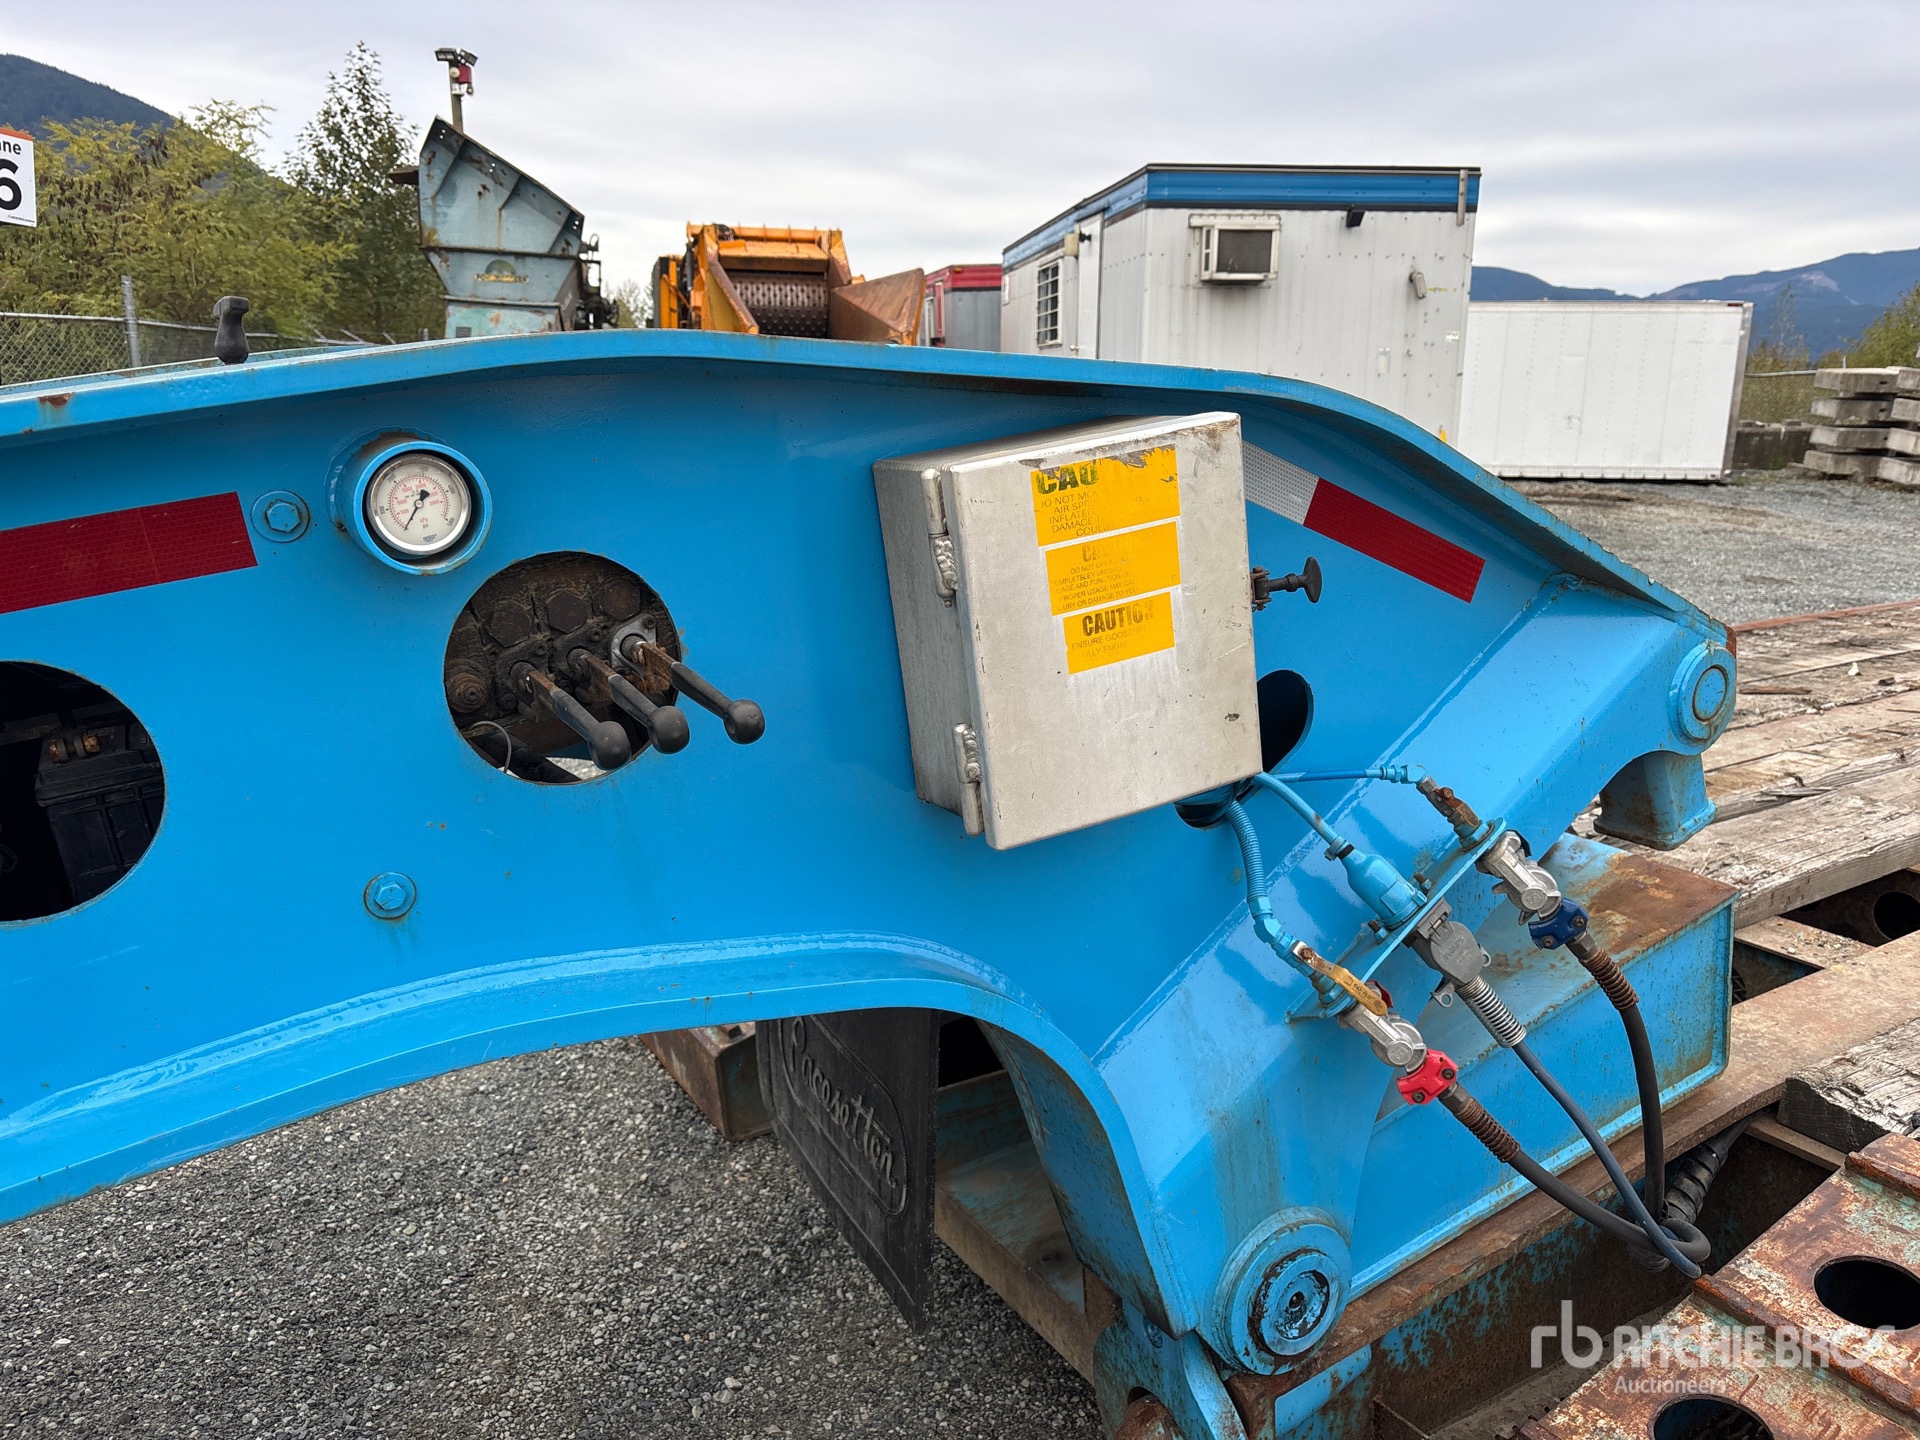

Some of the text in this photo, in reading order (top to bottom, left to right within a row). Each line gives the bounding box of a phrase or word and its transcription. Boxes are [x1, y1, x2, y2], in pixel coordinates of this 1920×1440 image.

[0, 140, 21, 155] ne
[1055, 494, 1075, 504] NOT
[1054, 504, 1069, 514] AIR
[1052, 518, 1093, 533] DAMAGE
[1071, 636, 1103, 650] ENSURE
